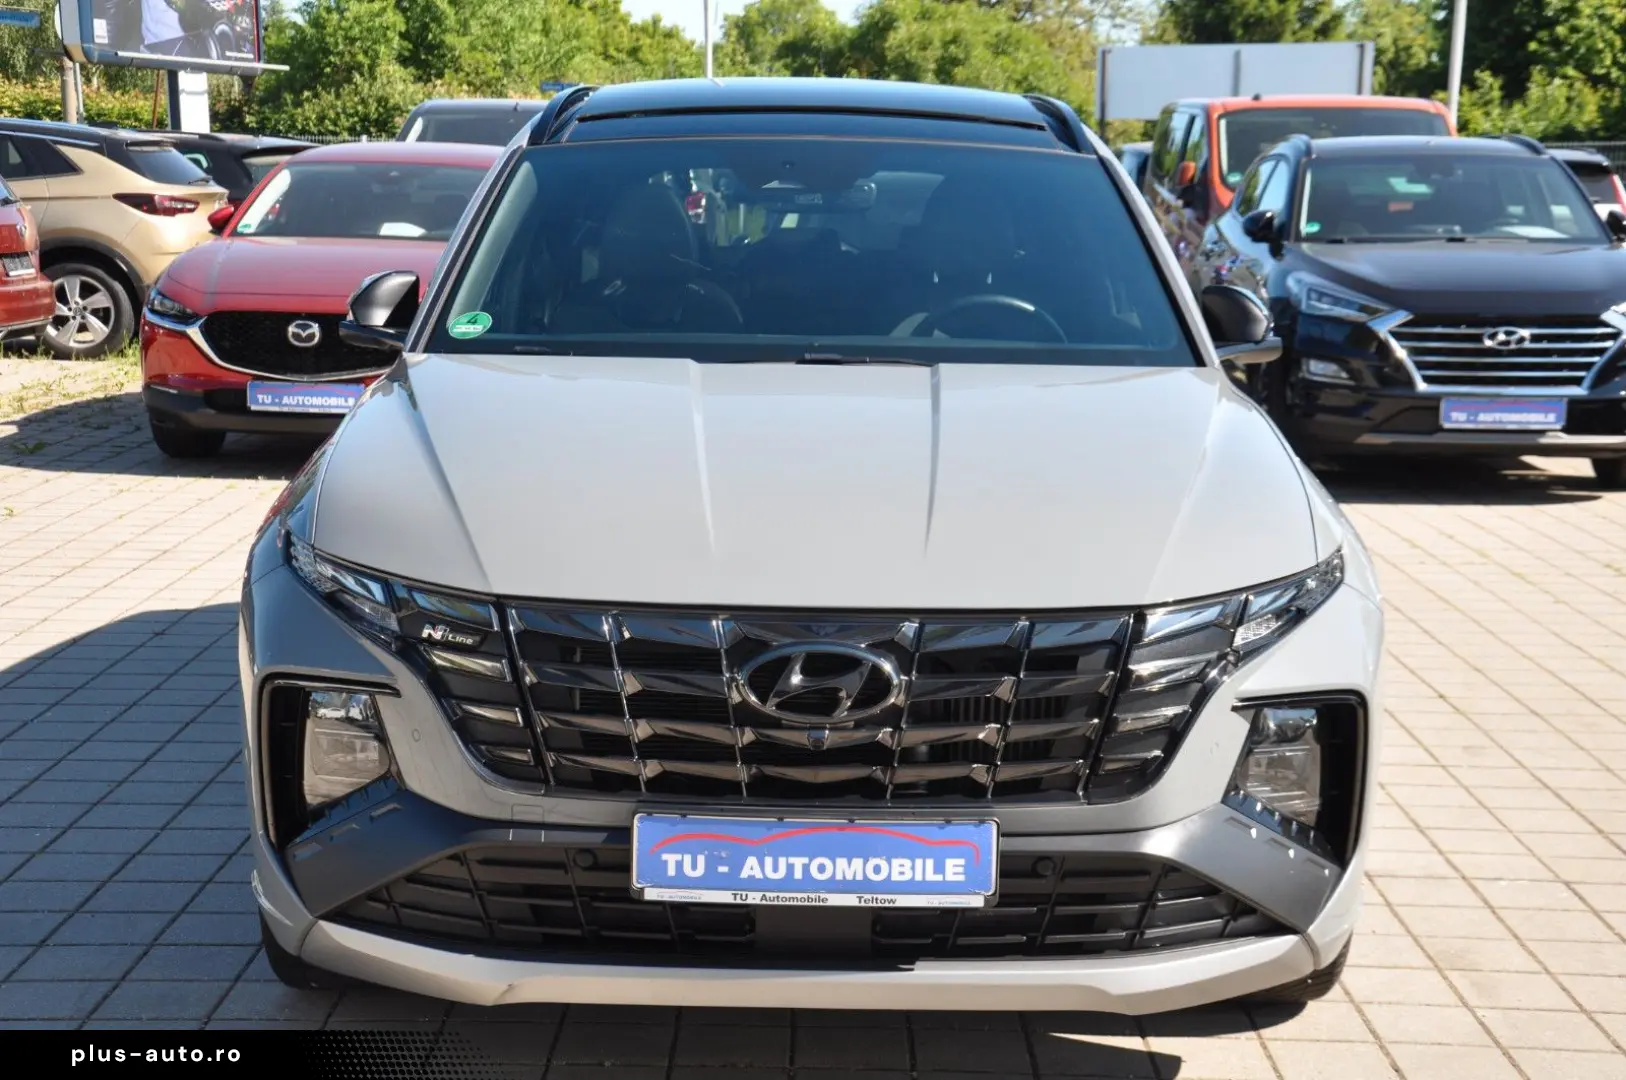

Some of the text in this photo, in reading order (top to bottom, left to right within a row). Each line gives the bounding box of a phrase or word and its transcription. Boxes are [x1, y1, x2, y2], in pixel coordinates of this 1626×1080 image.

[466, 314, 479, 325] 4
[257, 395, 272, 403] TU
[661, 853, 705, 878] TU
[739, 856, 966, 882] AUTOMOBILE
[731, 892, 749, 902] TU
[759, 893, 829, 904] Automobile
[856, 895, 898, 905] Teltow
